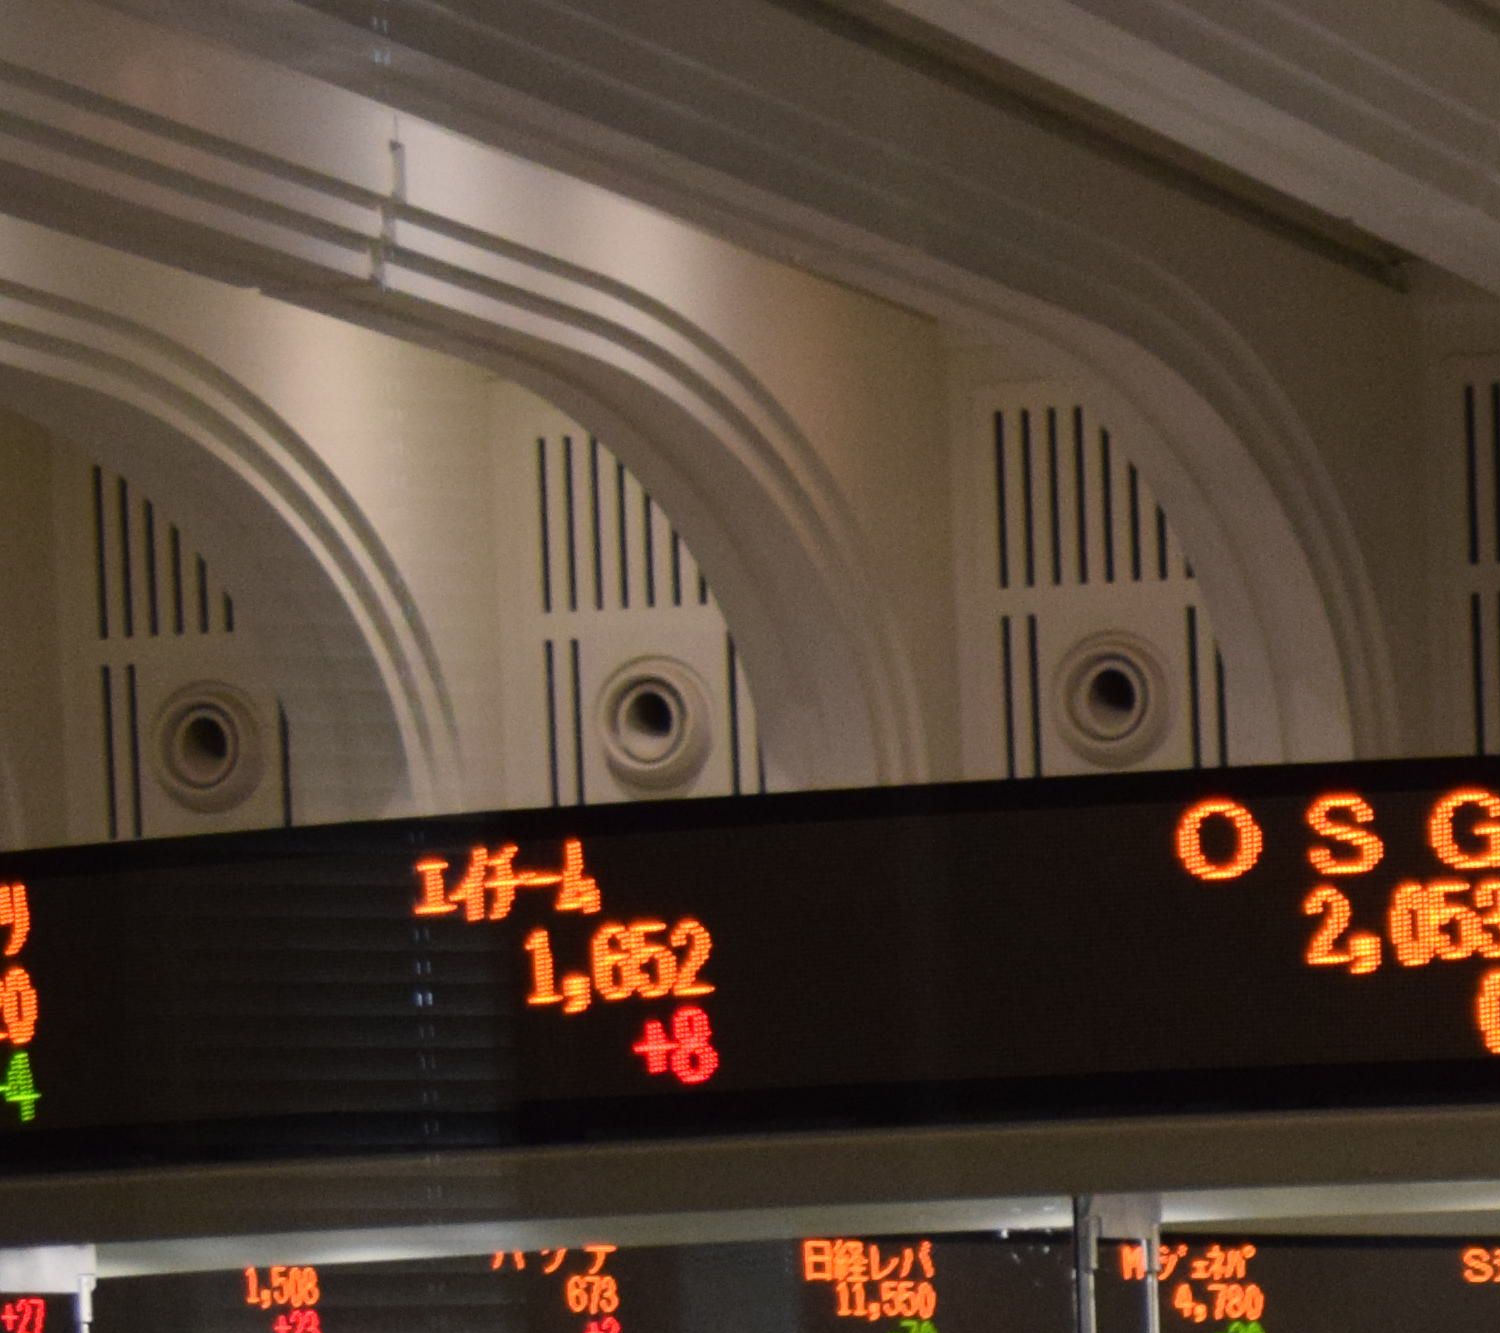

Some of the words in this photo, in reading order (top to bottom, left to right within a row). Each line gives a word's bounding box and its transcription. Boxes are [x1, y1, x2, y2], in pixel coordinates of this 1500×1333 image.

[526, 921, 714, 1013] 1,652
[634, 1006, 718, 1082] +8
[802, 1240, 936, 1281] 日経レバ
[244, 1266, 320, 1309] 1,508
[565, 1274, 620, 1315] 673
[836, 1282, 937, 1321] 11,550
[1174, 1282, 1264, 1322] 4,780
